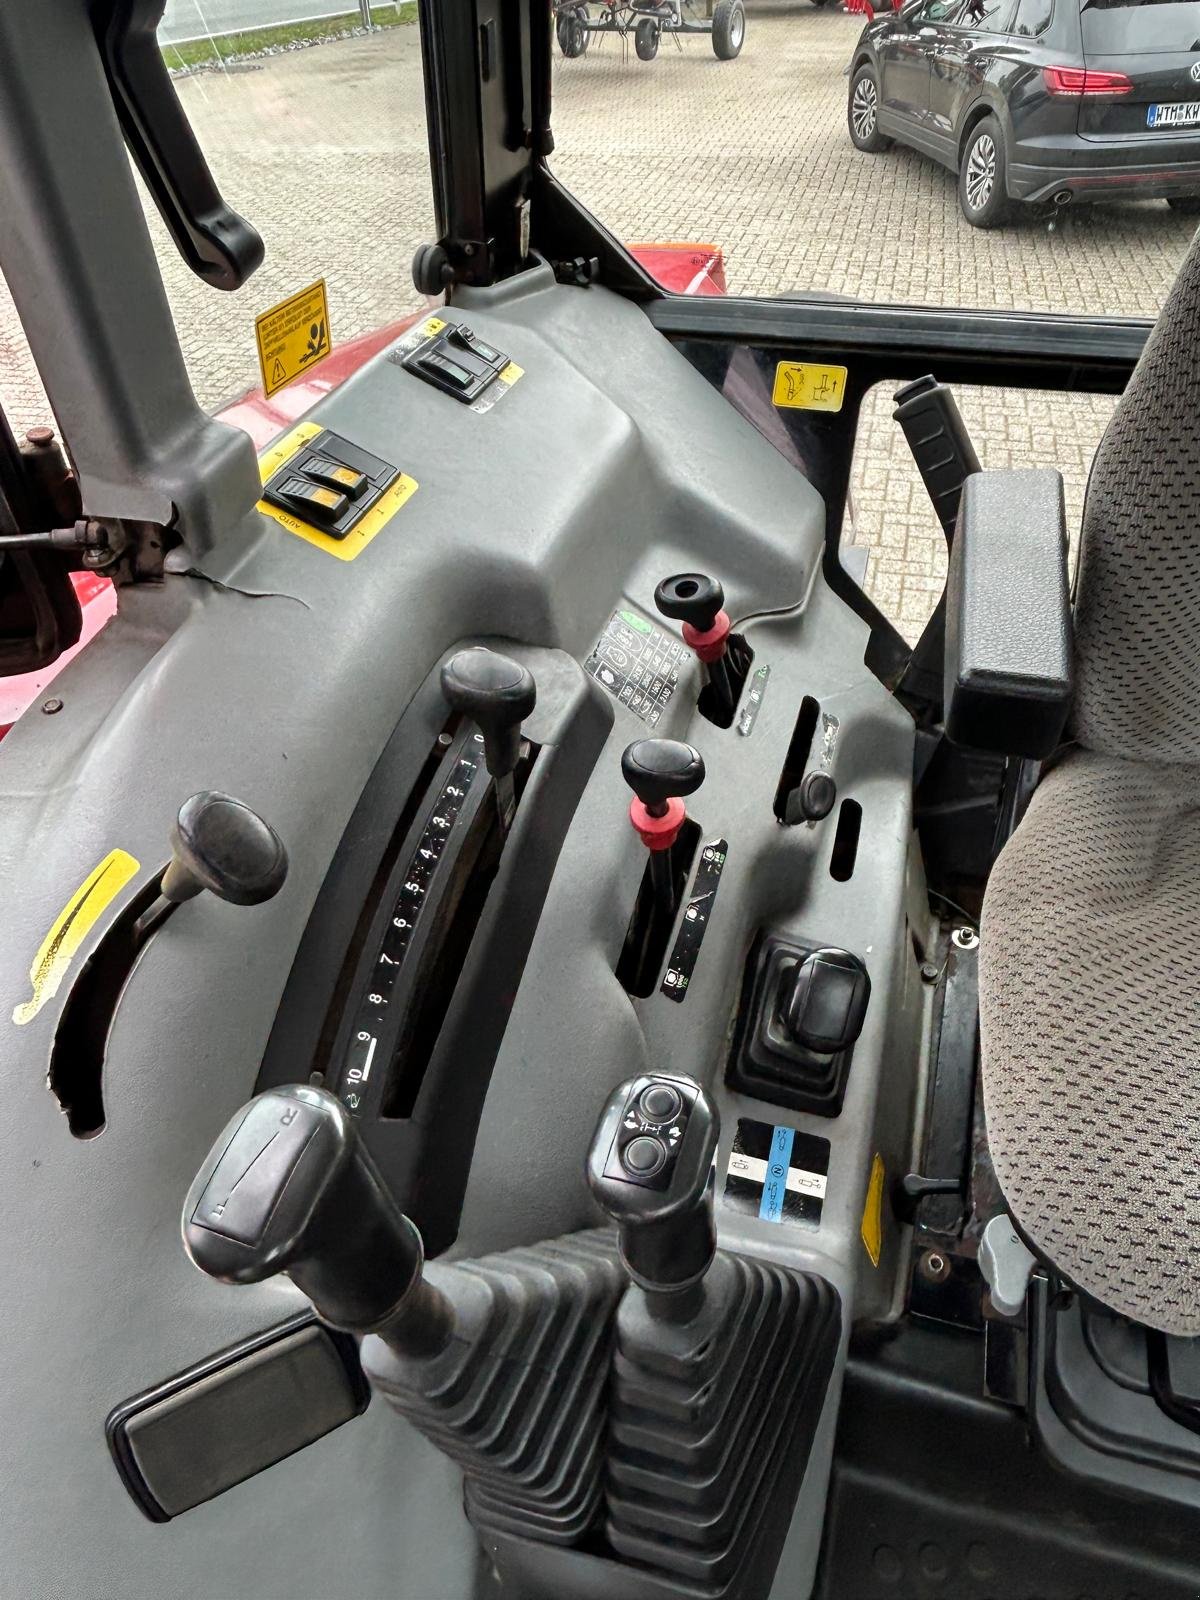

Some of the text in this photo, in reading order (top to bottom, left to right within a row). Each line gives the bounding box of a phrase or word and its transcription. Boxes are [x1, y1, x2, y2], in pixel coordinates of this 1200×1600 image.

[1156, 106, 1178, 121] WTM
[279, 515, 300, 528] AUTO
[474, 733, 485, 743] 0
[460, 759, 472, 767] 1
[447, 786, 459, 796] 2
[433, 817, 445, 827] 3
[420, 849, 432, 859] 4
[406, 882, 419, 893] 5
[393, 917, 406, 928] 6
[380, 954, 394, 964] 7
[369, 993, 383, 1004] 8
[357, 1031, 371, 1042] 9
[347, 1068, 363, 1084] 10
[281, 1108, 298, 1125] R
[212, 1199, 228, 1216] F
